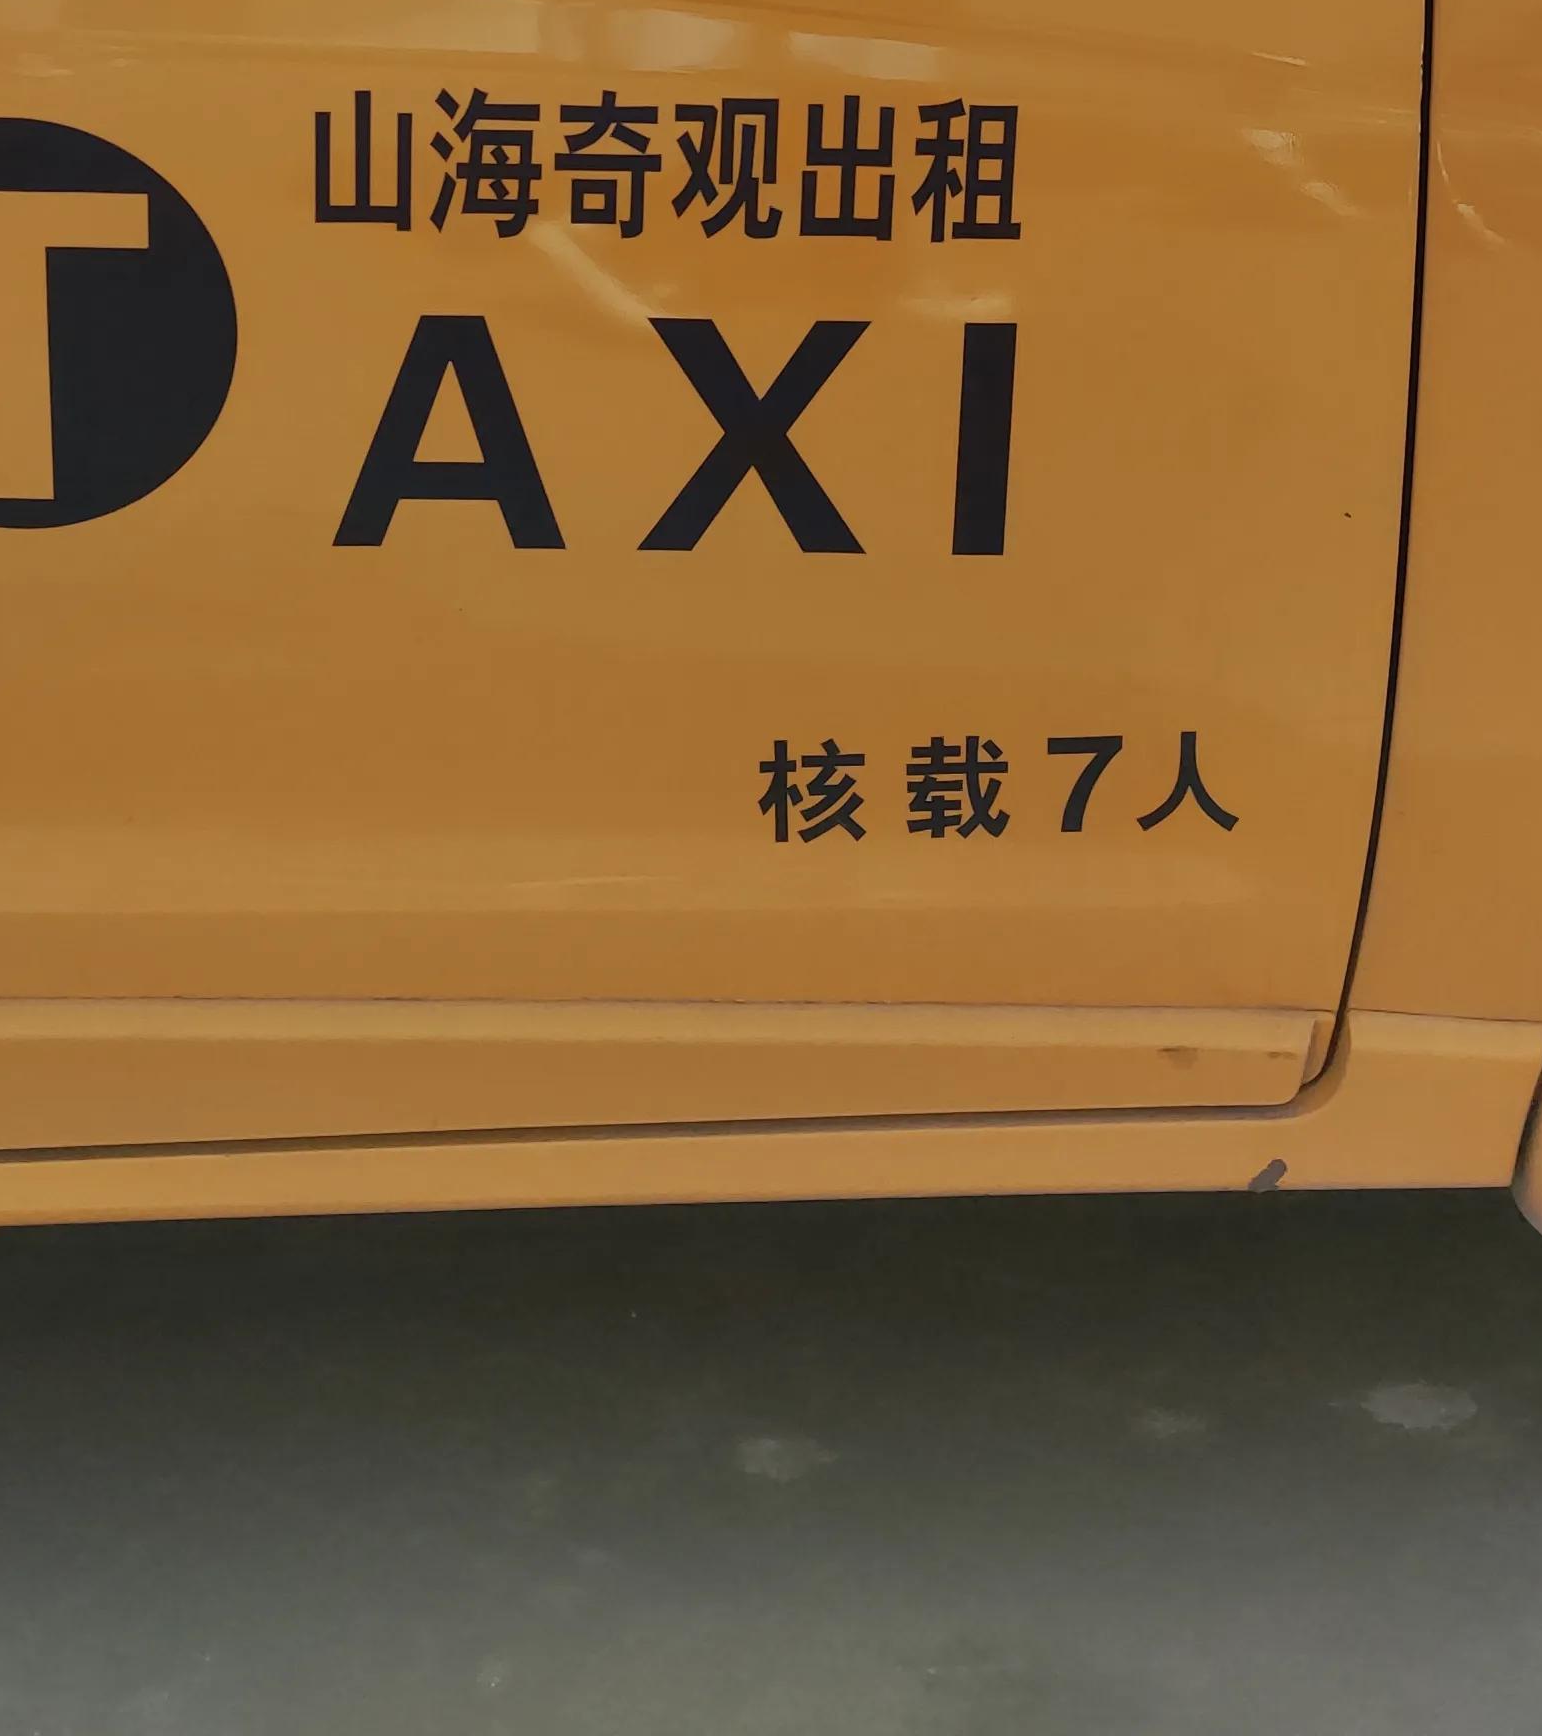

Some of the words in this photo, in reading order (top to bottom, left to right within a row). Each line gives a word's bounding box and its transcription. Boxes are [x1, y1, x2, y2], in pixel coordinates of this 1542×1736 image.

[313, 88, 1022, 244] 山海奇观出租
[757, 730, 1240, 844] 核载7人
